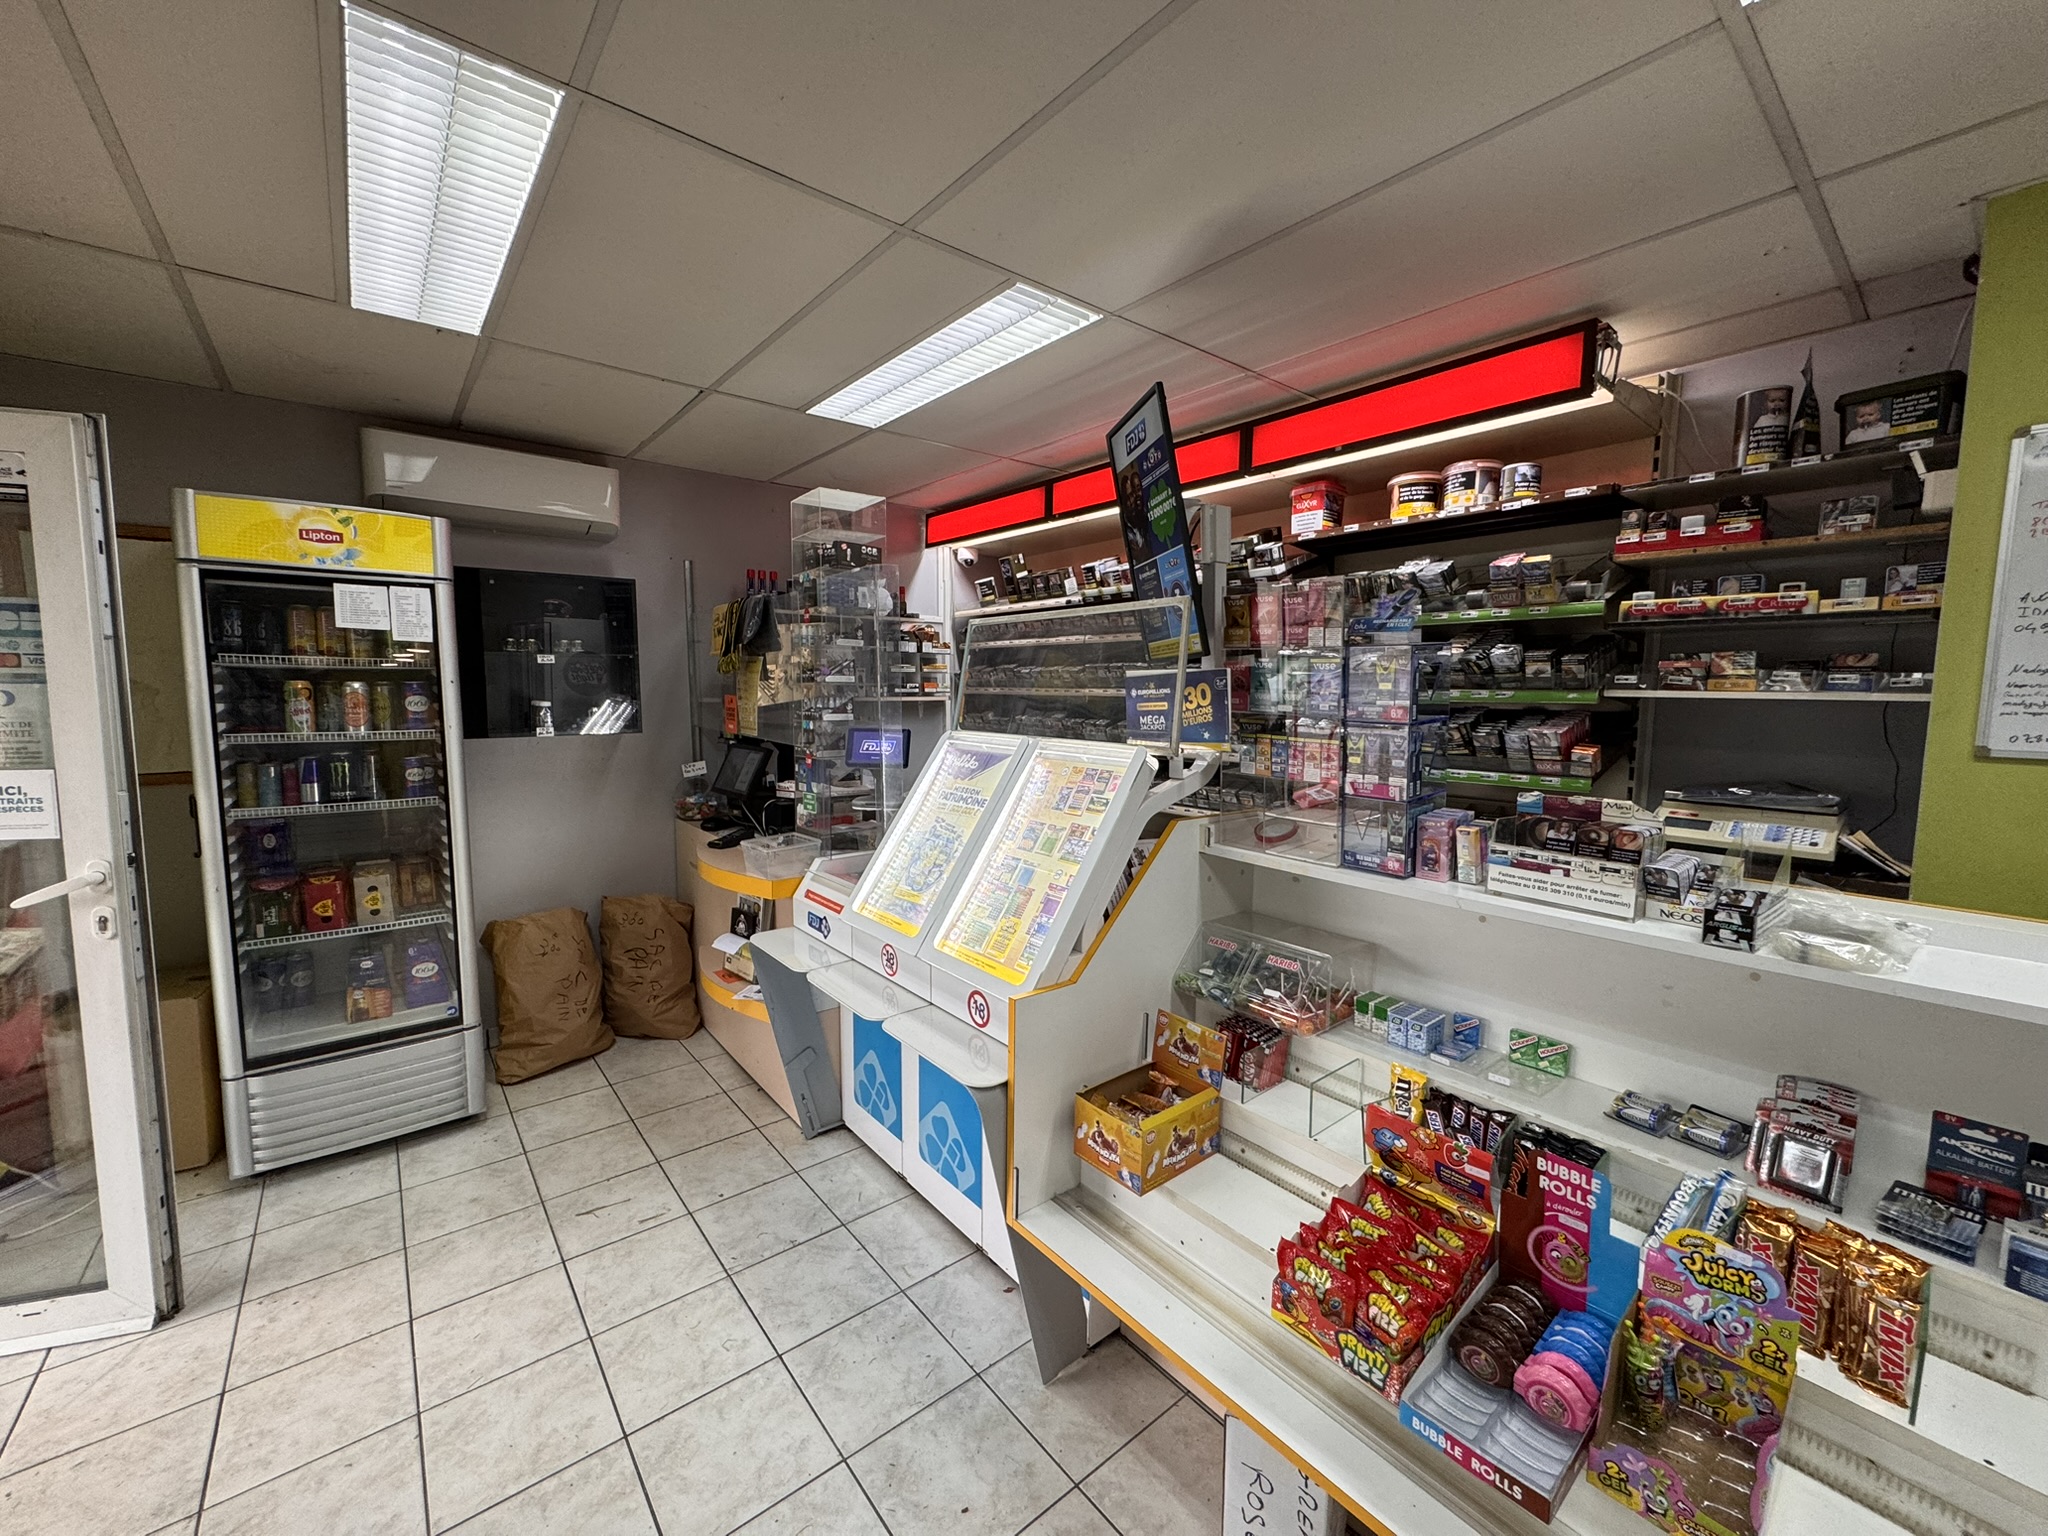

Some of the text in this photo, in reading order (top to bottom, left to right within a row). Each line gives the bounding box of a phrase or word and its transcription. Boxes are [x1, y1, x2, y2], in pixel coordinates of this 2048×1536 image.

[1893, 400, 1917, 408] fumeurs
[1904, 392, 1929, 401] enfants
[1915, 402, 1938, 411] risques
[1763, 426, 1785, 434] enfant
[1127, 430, 1139, 453] FDJ
[302, 530, 340, 543] Lipton
[861, 546, 878, 556] OCB
[1137, 687, 1171, 695] EUROMILLIONS
[1182, 705, 1213, 718] MILLIONS
[1182, 713, 1213, 727] D'EUROS
[939, 790, 988, 809] PATRIMOINE
[953, 785, 981, 796] MISSION
[2, 797, 44, 805] TRAITS
[1604, 801, 1632, 811] Mini
[1490, 876, 1521, 888] téléphonez
[1498, 871, 1532, 882] Faites-vous
[1533, 877, 1549, 885] aider
[1550, 881, 1565, 889] pour
[1566, 883, 1589, 893] arrêter
[808, 912, 819, 928] FDJ
[1660, 908, 1703, 924] NEOS
[1705, 920, 1738, 931] ARGUS
[645, 928, 665, 971] SAC
[1208, 936, 1238, 950] HARIBO
[624, 947, 649, 993] PAIN
[1267, 955, 1300, 971] HARIBO
[555, 974, 573, 1022] PAIN
[1783, 1125, 1838, 1145] HEAVY DUTY
[1938, 1136, 2015, 1163] ANSMANN
[1935, 1148, 2017, 1177] ALKALINE BATTERY
[1536, 1156, 1602, 1194] BUBBLE
[1539, 1174, 1597, 1210] ROLLS
[1552, 1203, 1584, 1217] dérouler
[1693, 1271, 1767, 1304] WORMS
[1368, 1306, 1399, 1338] FIZZ
[1338, 1332, 1390, 1372] FRUTTI
[1761, 1339, 1786, 1360] 2x
[1878, 1309, 1916, 1393] TWIX
[1344, 1351, 1387, 1389] FIZZ
[1750, 1350, 1787, 1375] GEL
[1411, 1415, 1523, 1501] BUBBLE ROLLS
[1604, 1461, 1628, 1481] 2x
[1599, 1472, 1632, 1497] GEL
